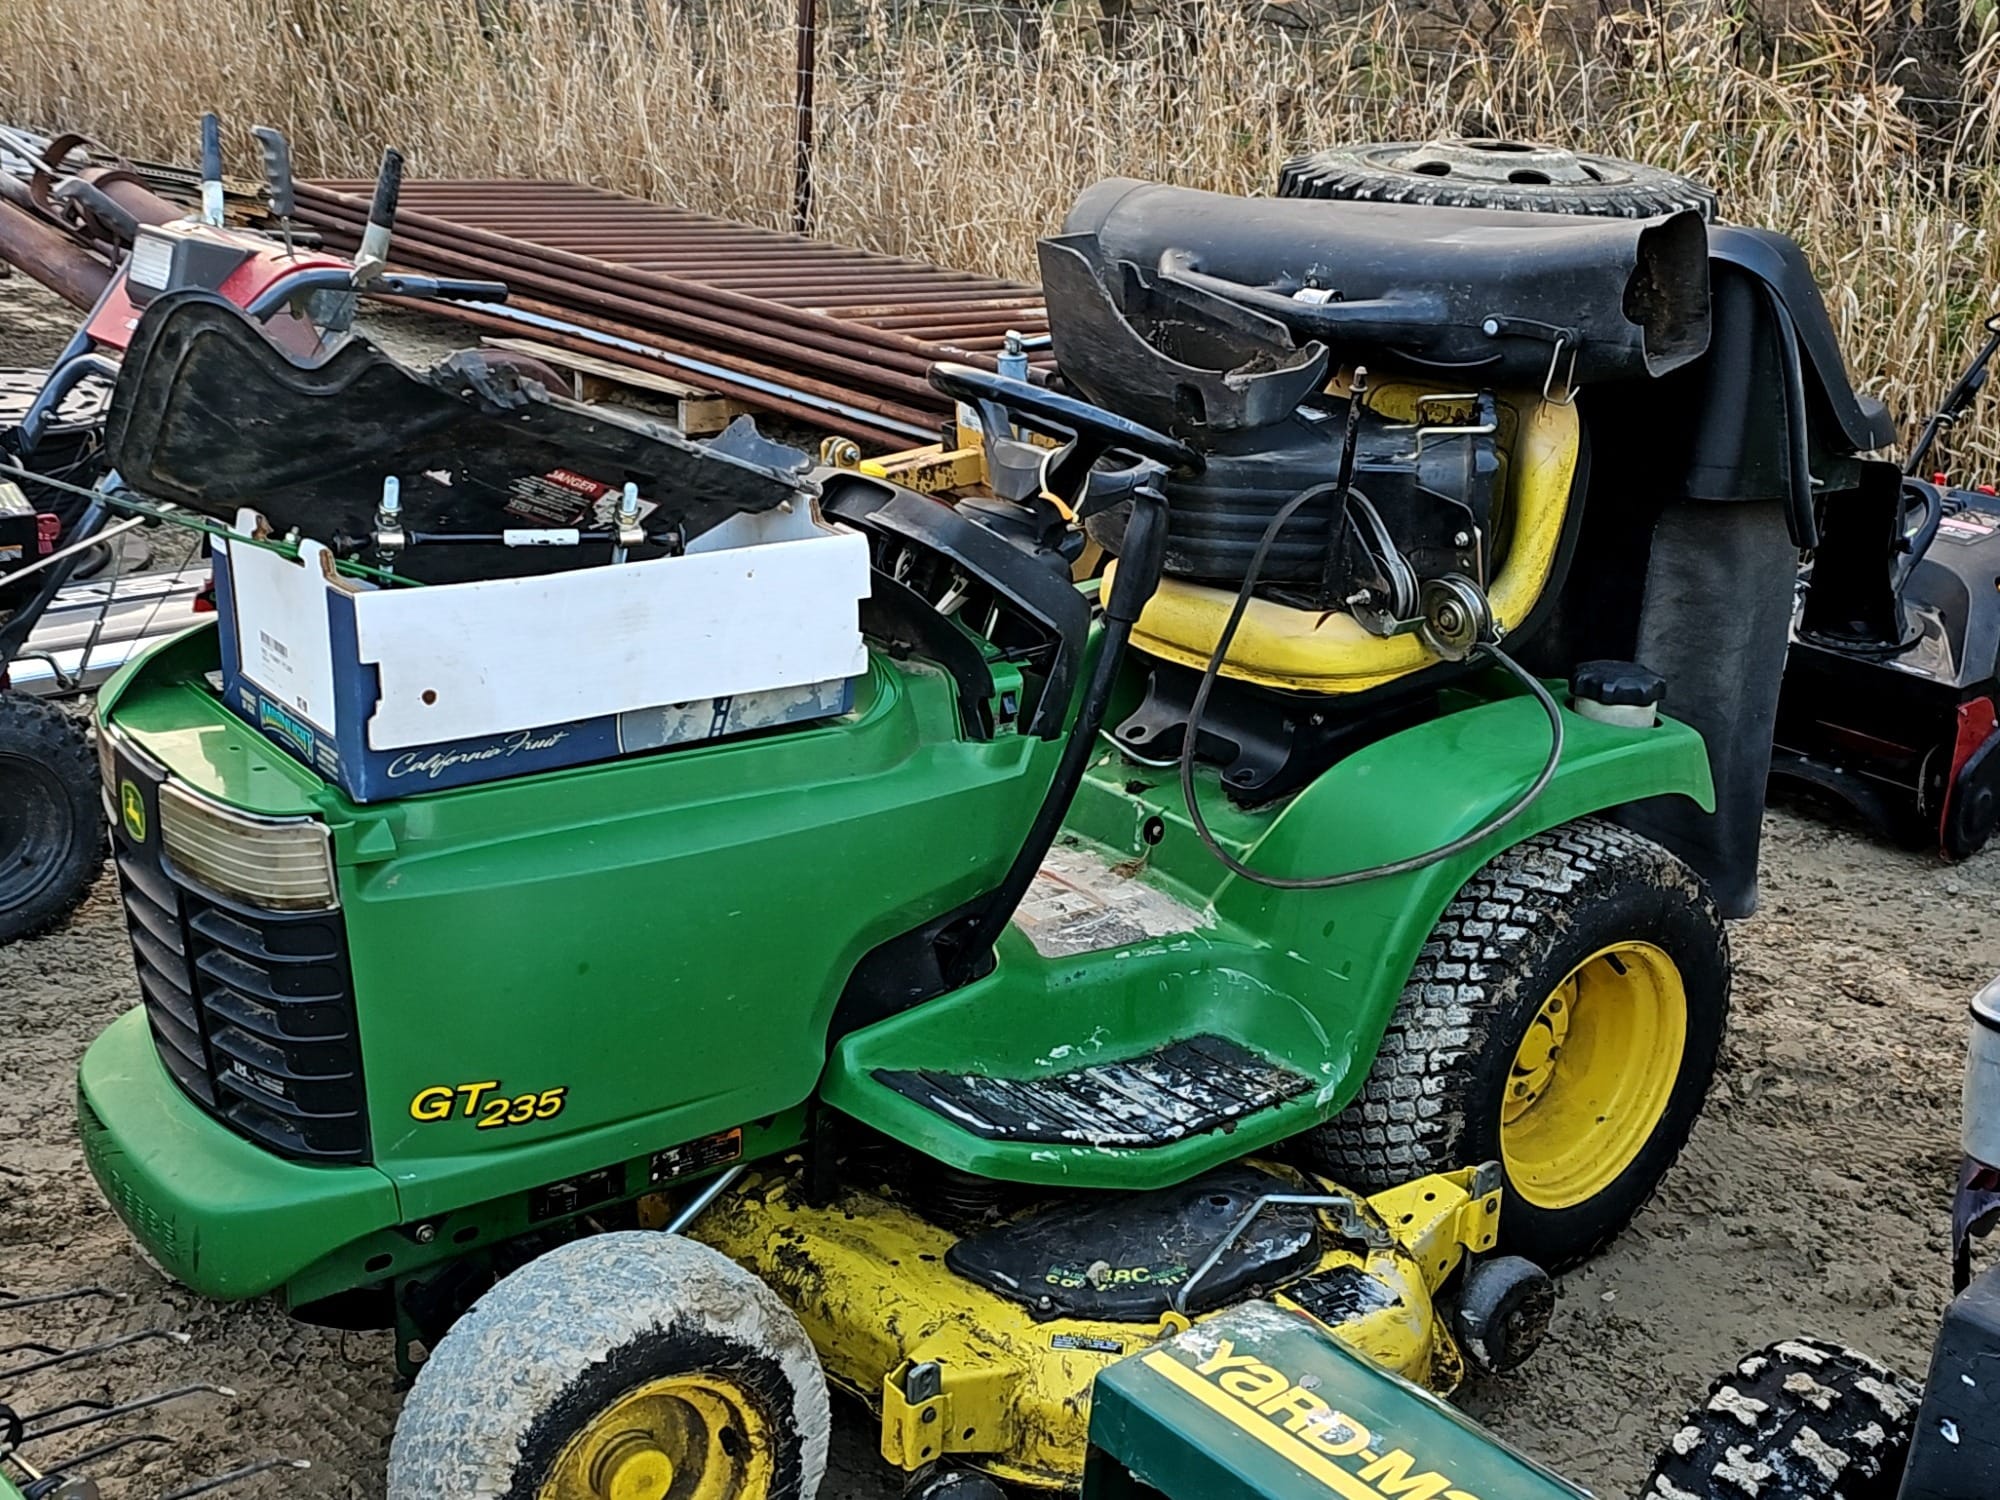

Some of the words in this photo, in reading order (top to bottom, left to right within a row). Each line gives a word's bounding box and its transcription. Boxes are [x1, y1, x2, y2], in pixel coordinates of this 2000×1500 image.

[387, 745, 504, 779] California
[503, 730, 570, 757] Fruit
[410, 1080, 567, 1129] GT235
